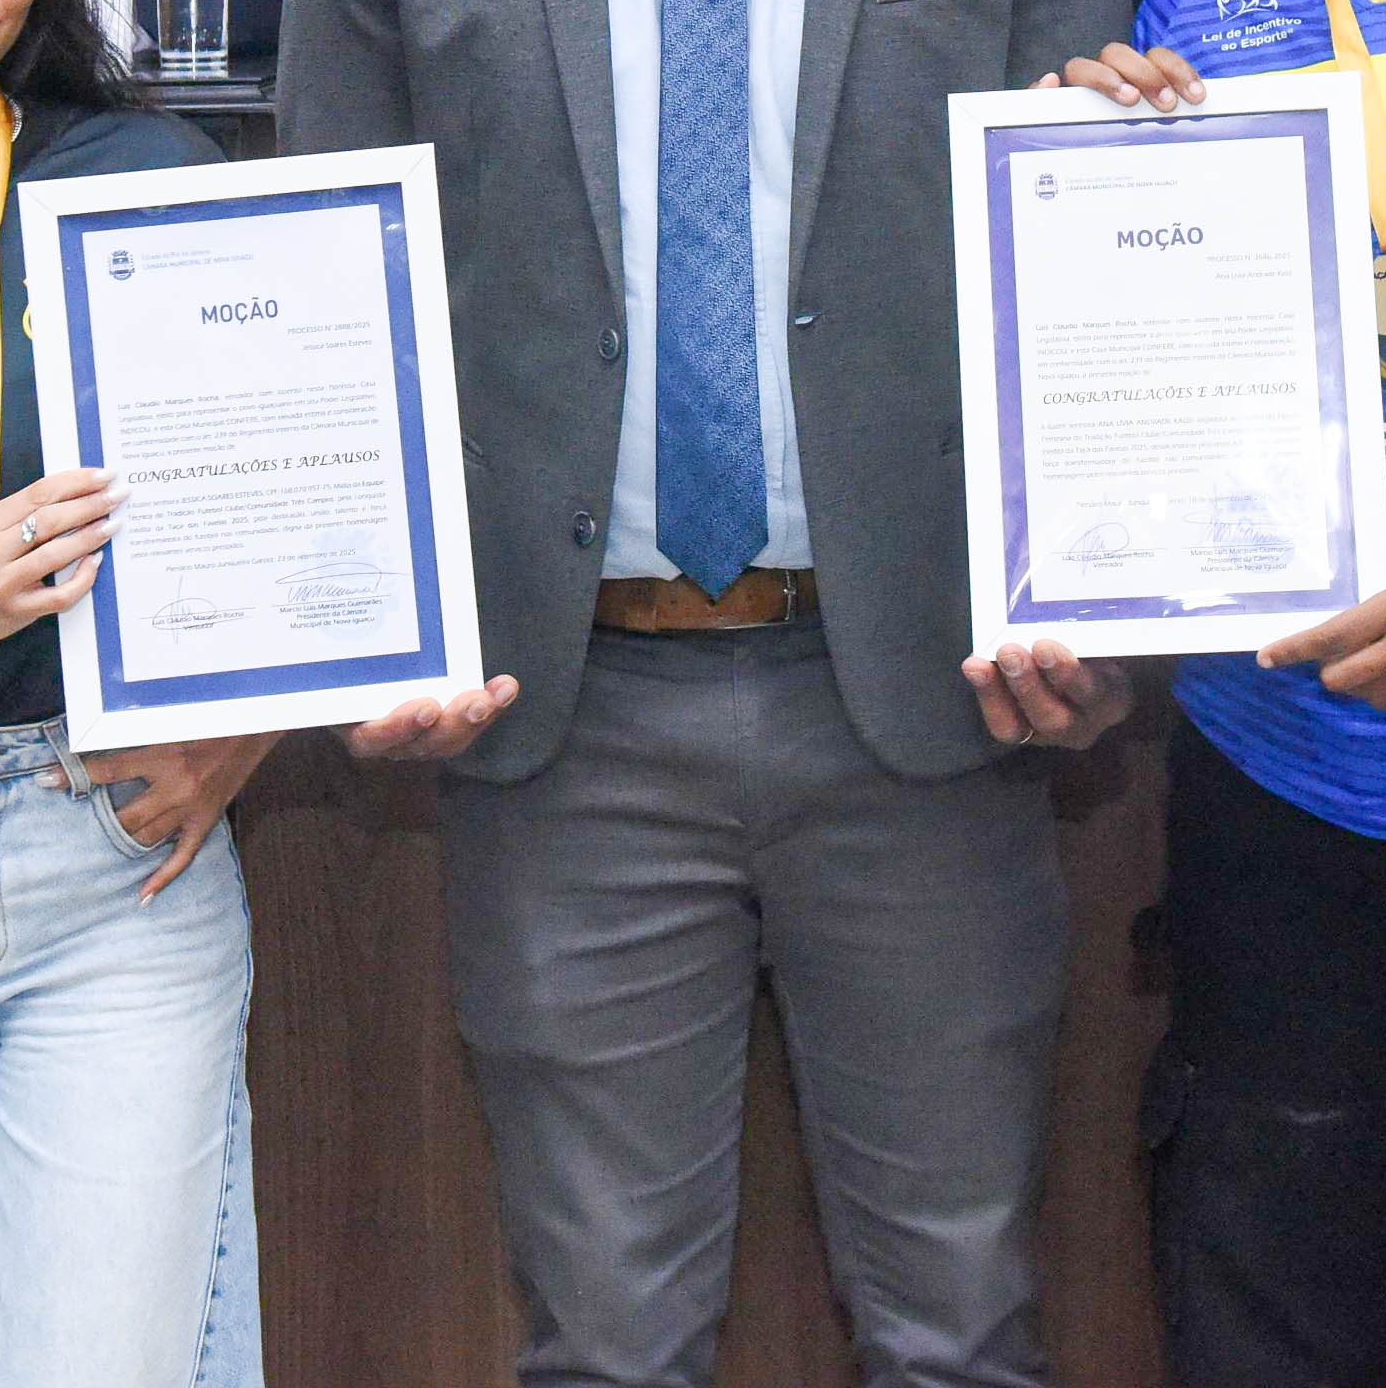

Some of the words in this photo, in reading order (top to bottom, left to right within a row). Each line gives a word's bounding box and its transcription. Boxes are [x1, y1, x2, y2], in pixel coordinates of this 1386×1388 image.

[1202, 31, 1222, 43] Lei
[1226, 28, 1242, 39] de
[1245, 16, 1302, 35] Incentivo
[1221, 42, 1237, 51] ao
[1117, 222, 1204, 251] MOÇÃO
[201, 296, 279, 325] MOÇÃO
[1042, 385, 1193, 406] CONGRATULAÇÕES
[1197, 385, 1207, 398] E
[1213, 380, 1297, 398] APLAUSOS
[127, 457, 278, 487] CONGRATULAÇÕES
[282, 455, 293, 470] E
[298, 446, 381, 469] APLAUSOS
